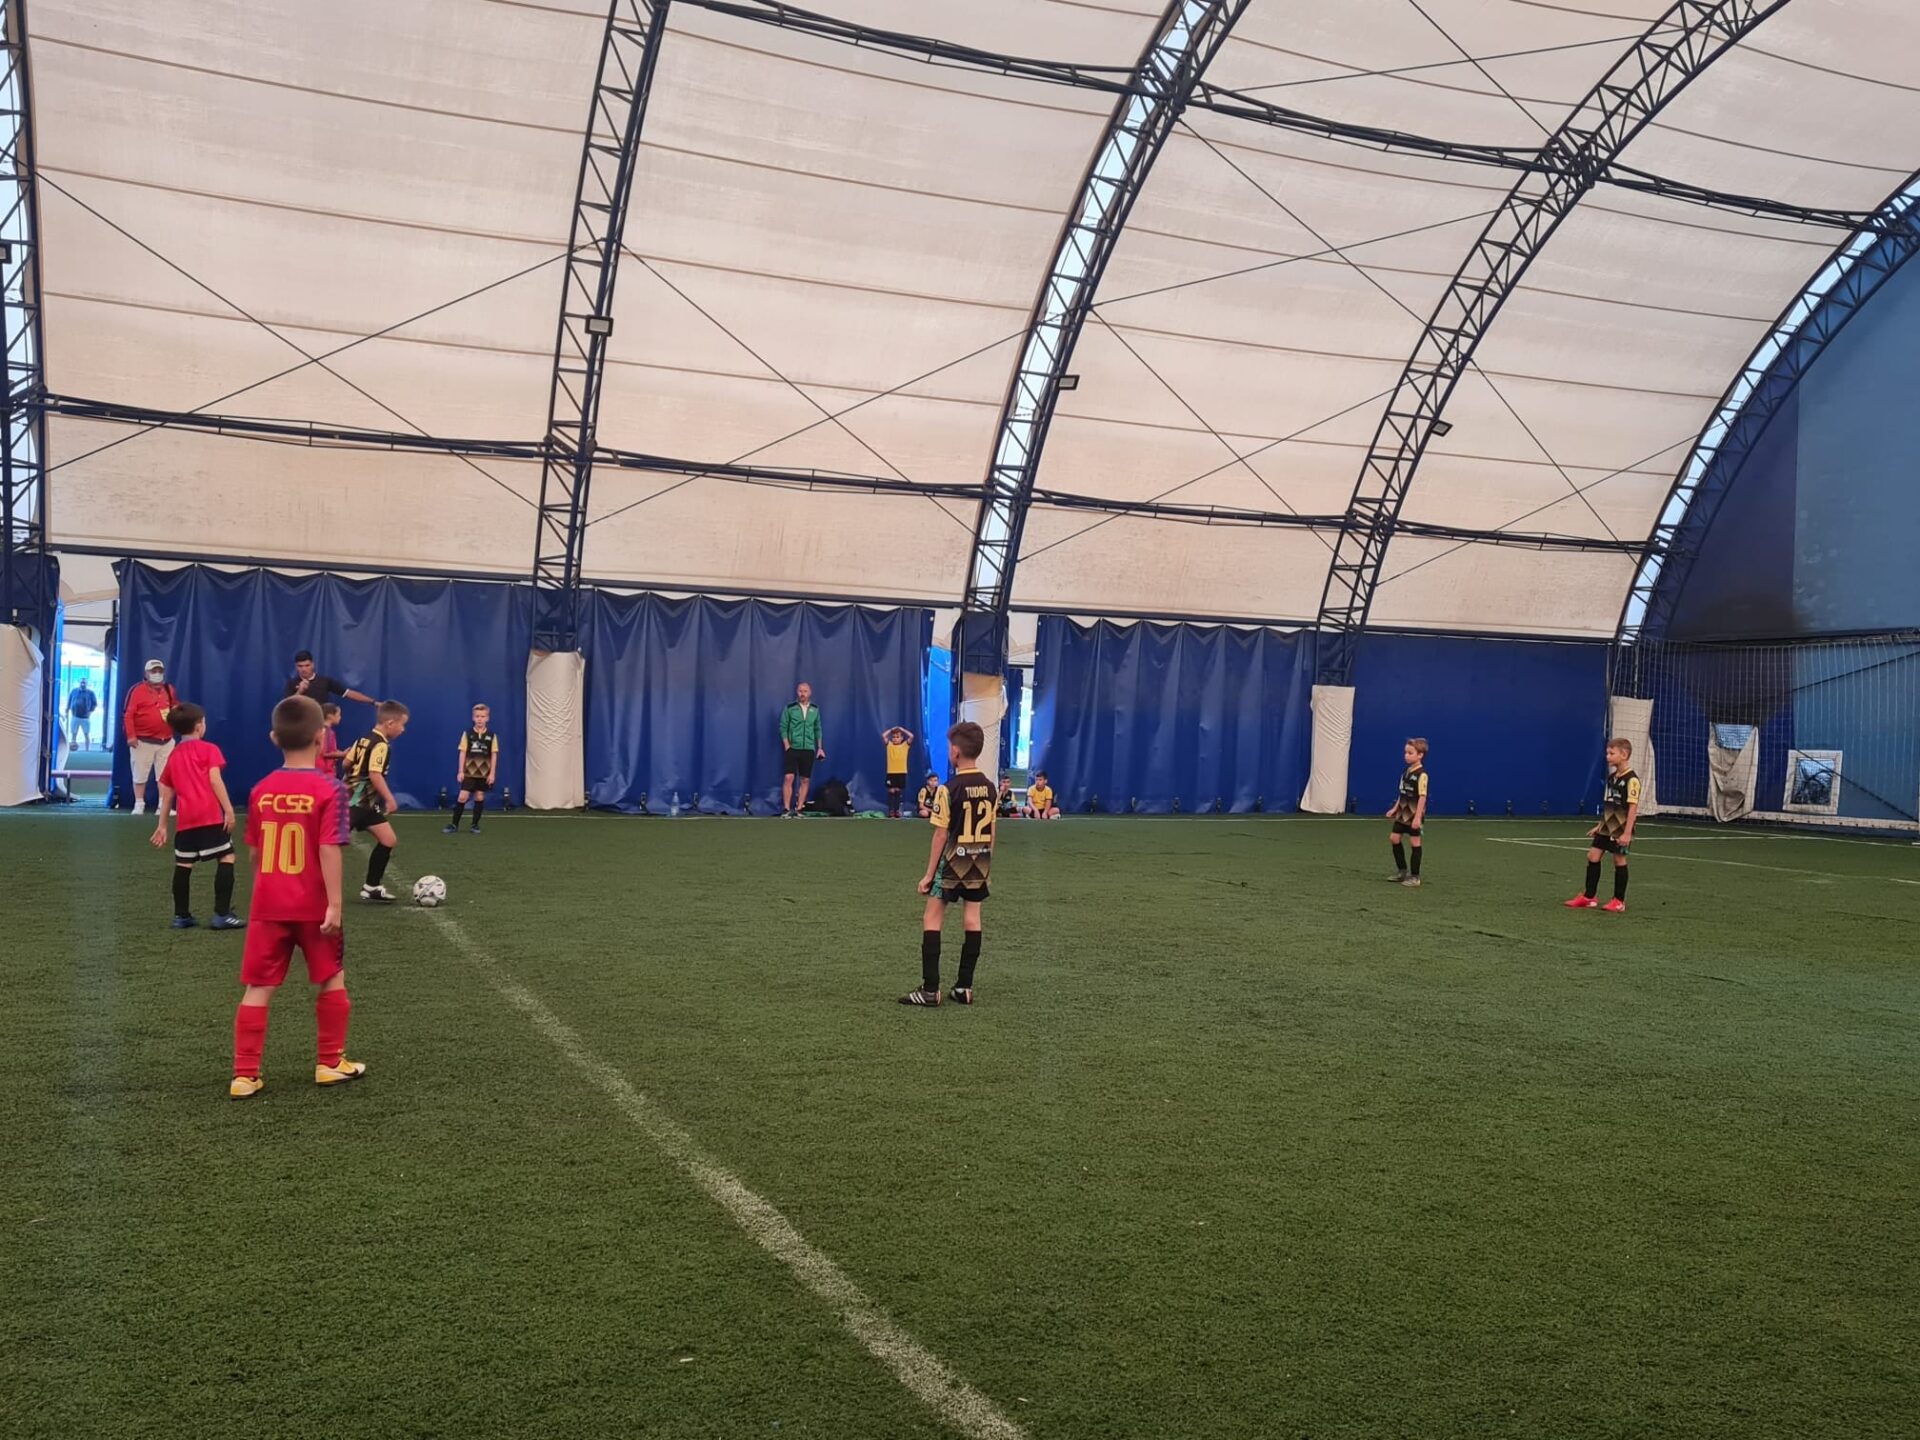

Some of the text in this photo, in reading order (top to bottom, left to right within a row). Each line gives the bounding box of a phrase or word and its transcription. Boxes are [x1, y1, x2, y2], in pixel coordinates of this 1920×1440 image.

[257, 793, 315, 814] FCSB
[965, 785, 989, 798] TUDOR
[957, 799, 992, 843] 12
[260, 821, 306, 875] 10
